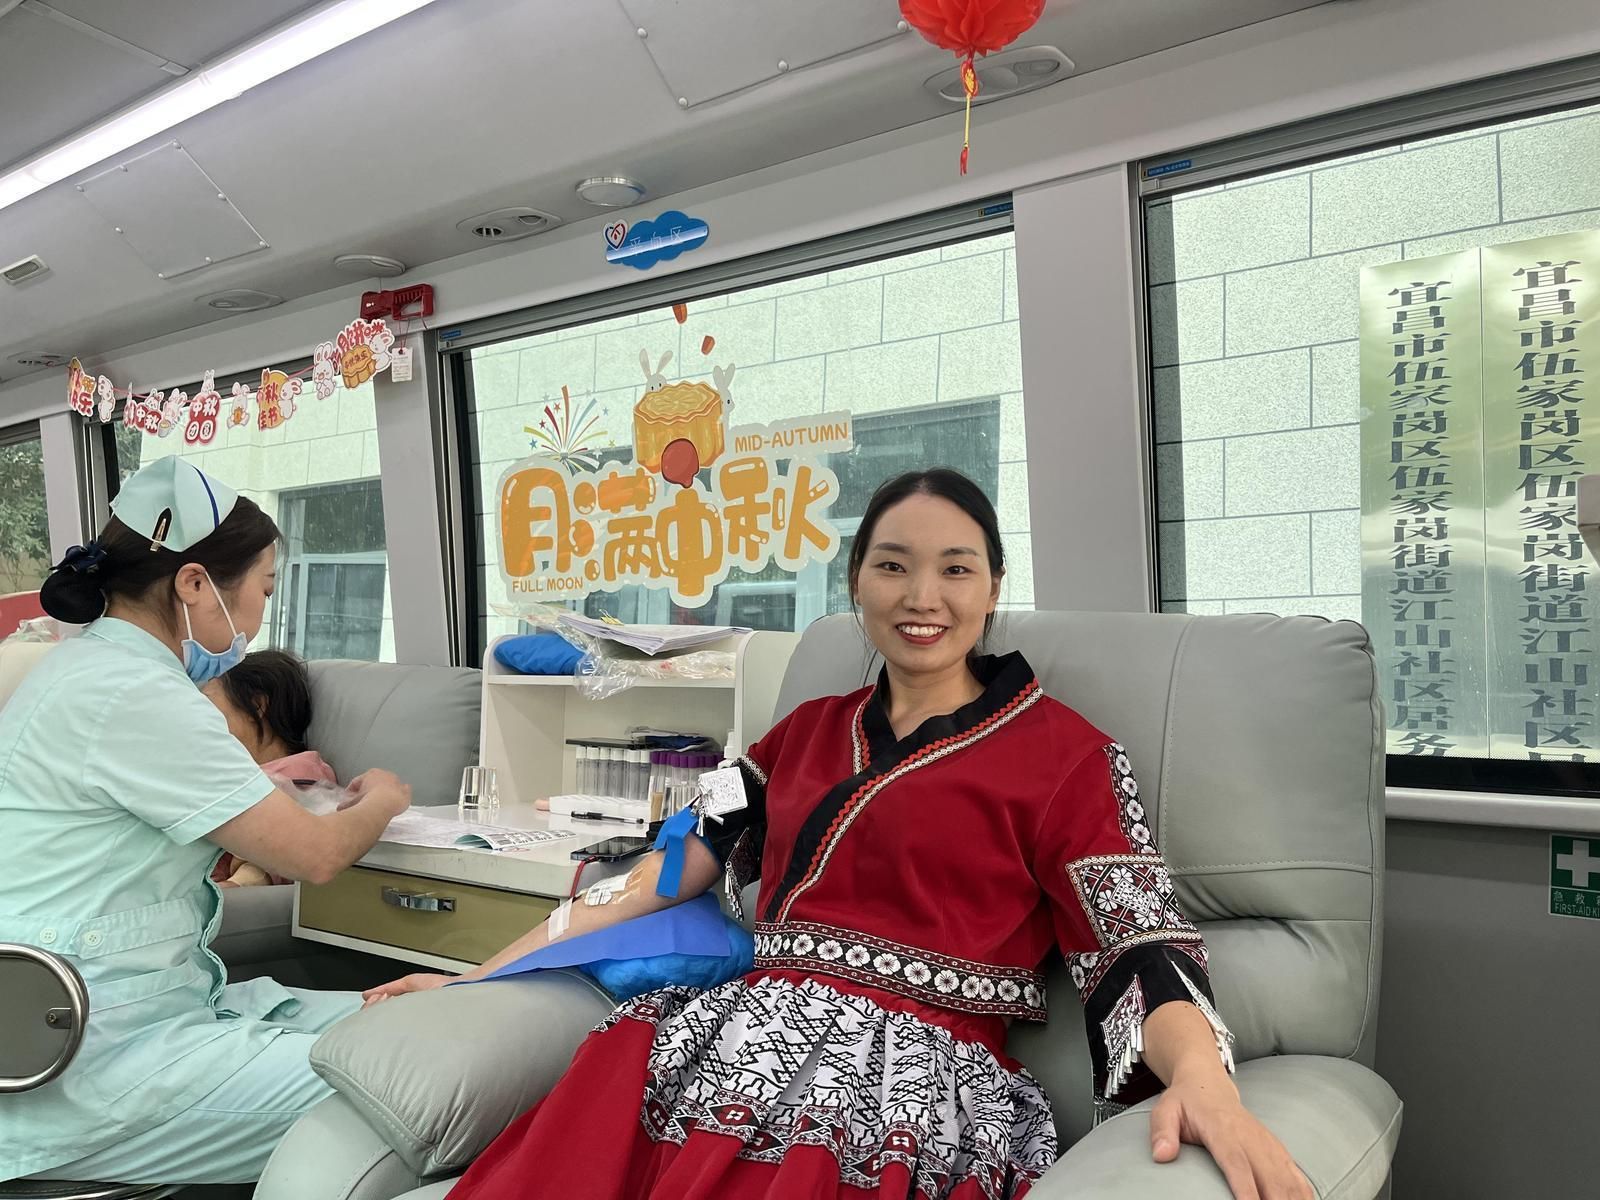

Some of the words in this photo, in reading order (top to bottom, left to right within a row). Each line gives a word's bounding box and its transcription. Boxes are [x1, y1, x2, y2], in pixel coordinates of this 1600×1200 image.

[193, 397, 217, 418] 中秋
[735, 422, 848, 453] MID-AUTUMN
[502, 456, 831, 597] 月满中秋
[1512, 260, 1592, 763] 宜昌市伍家岗区伍家岗街道江山社区
[512, 580, 544, 593] FULL
[547, 577, 584, 591] MOON
